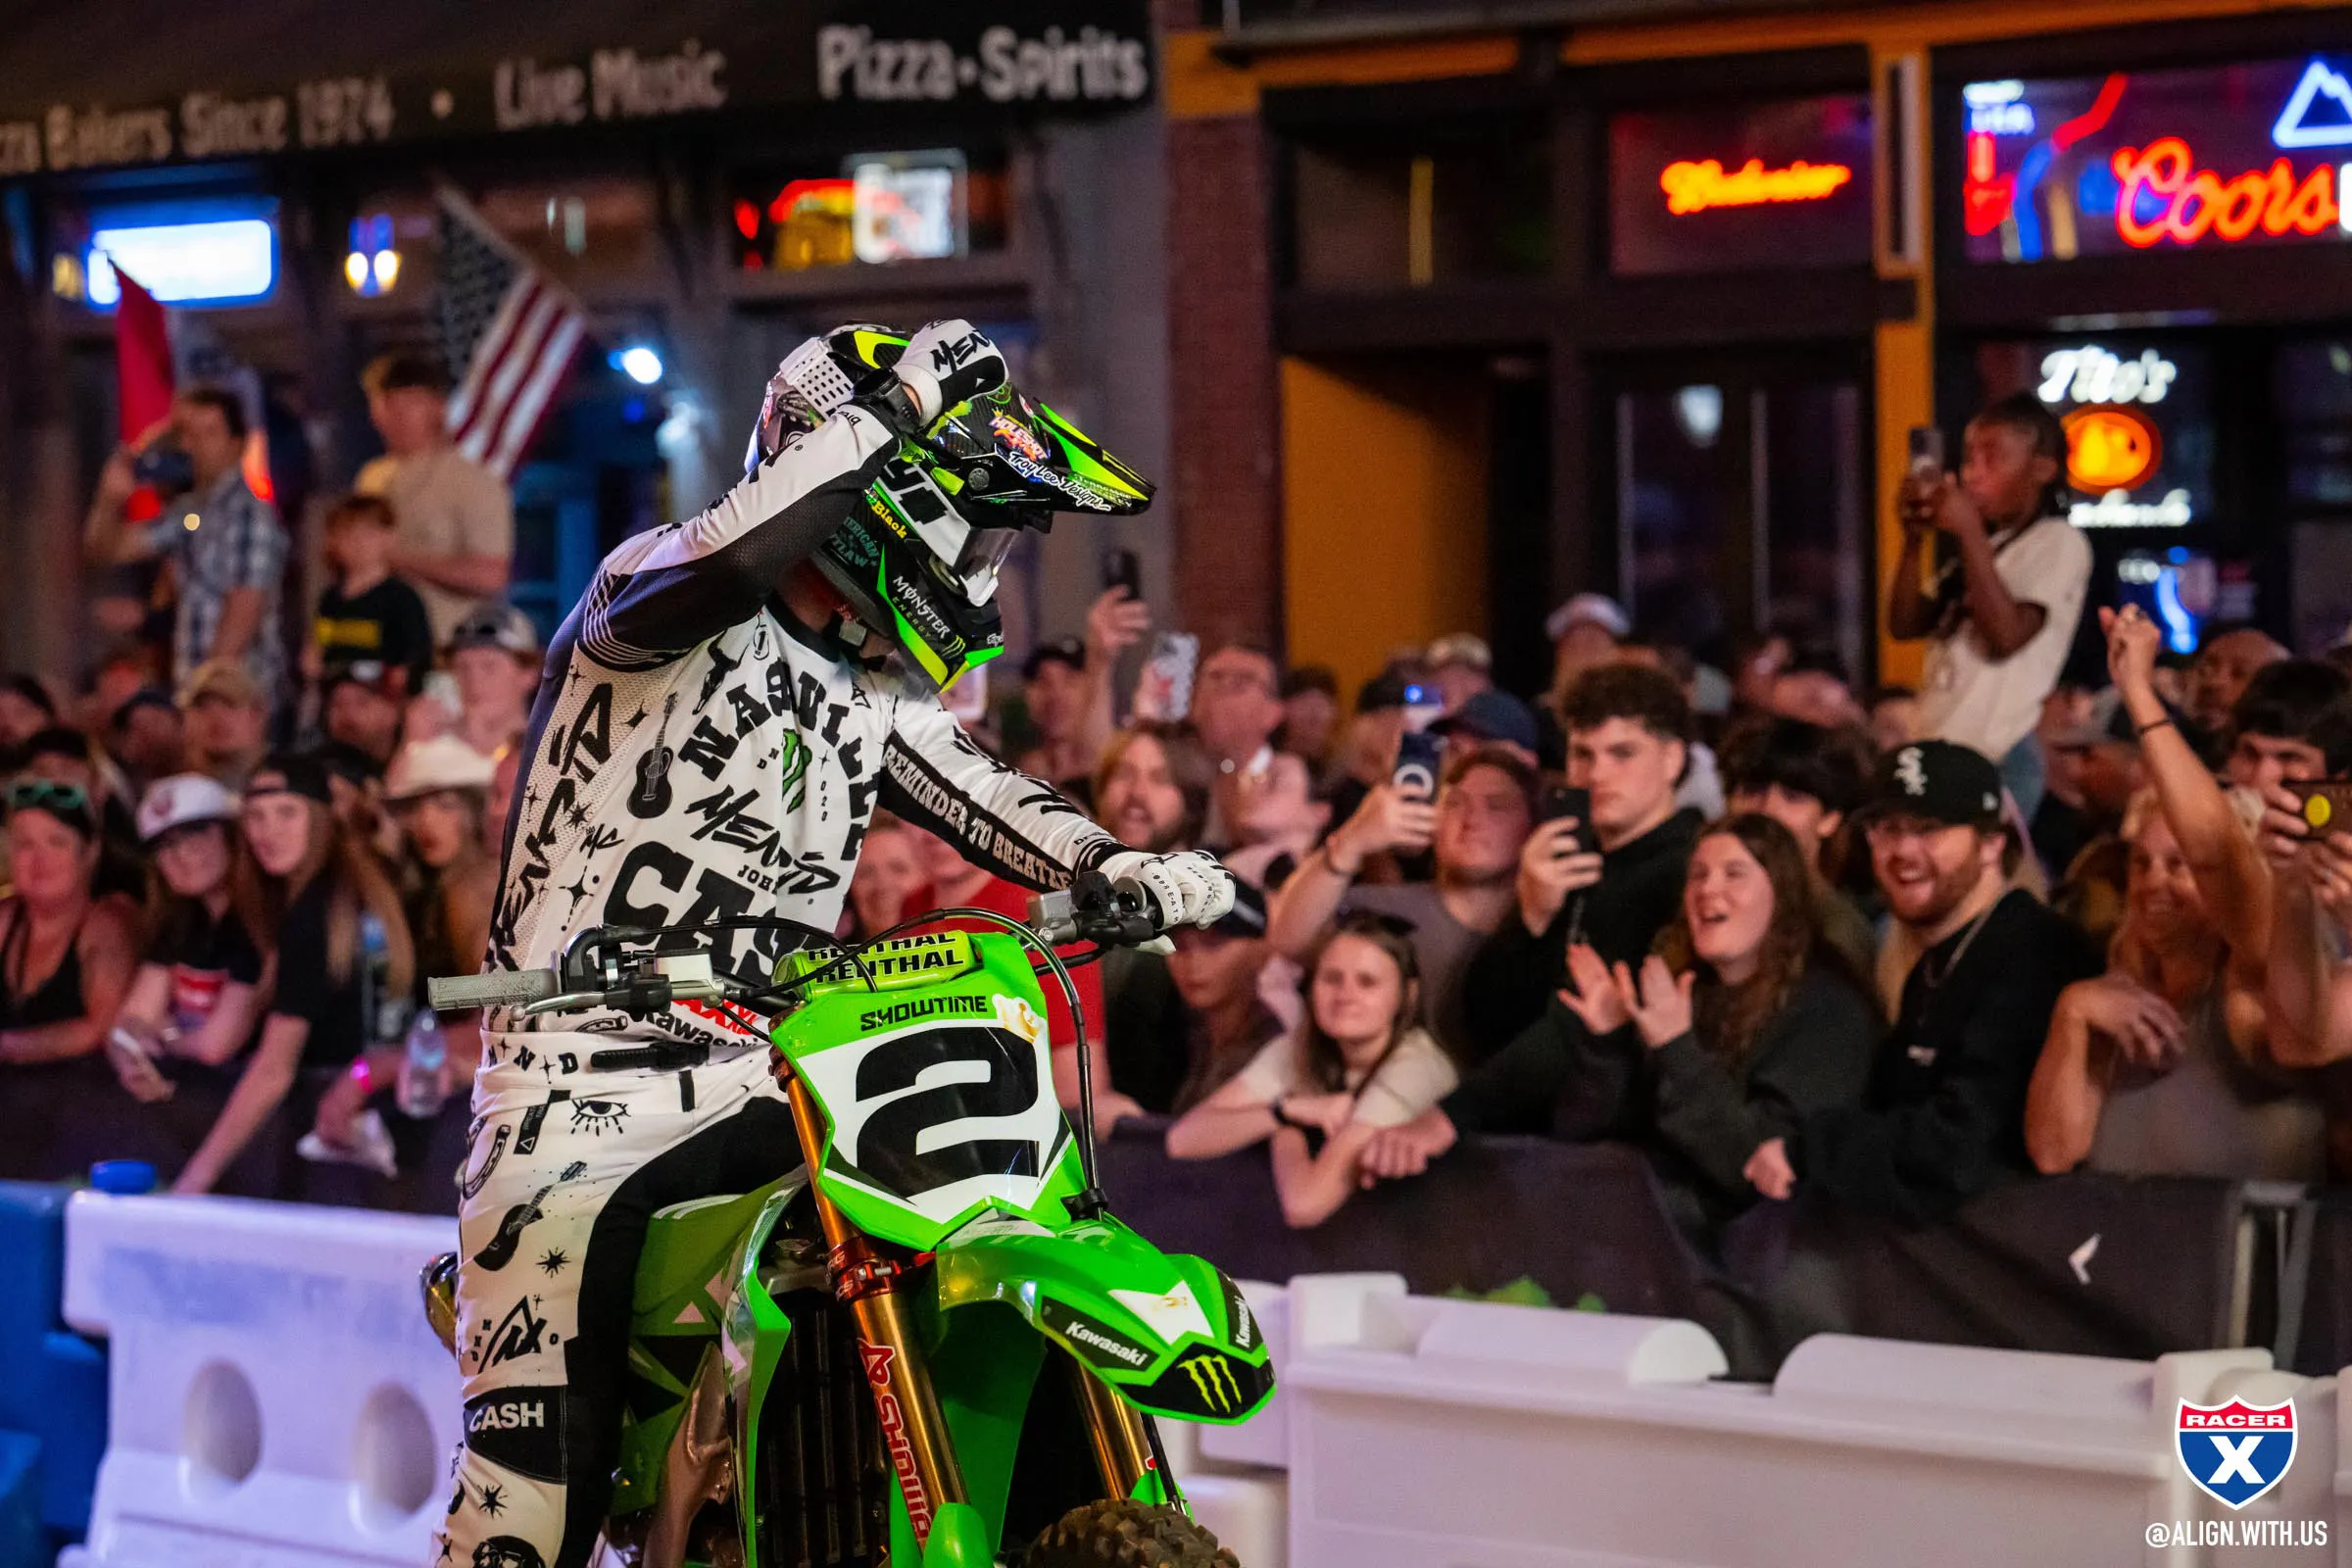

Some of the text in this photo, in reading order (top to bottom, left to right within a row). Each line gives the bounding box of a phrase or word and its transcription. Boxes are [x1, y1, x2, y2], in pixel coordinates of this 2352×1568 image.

[180, 92, 287, 157] Since
[494, 55, 587, 131] Live
[592, 37, 729, 121] Music
[816, 24, 956, 100] Pizza
[979, 25, 1149, 100] Spirits
[2112, 135, 2340, 249] Coors
[1009, 450, 1037, 478] Troy
[1056, 474, 1112, 512] Designs
[871, 500, 908, 539] Black
[882, 744, 969, 836] REMINDER
[967, 819, 994, 852] TO
[860, 995, 988, 1031] SHOWTIME
[856, 1026, 1039, 1199] 2
[1065, 1321, 1149, 1367] Kawasaki
[1234, 1295, 1251, 1349] Kawasaki
[468, 1401, 545, 1433] CASH
